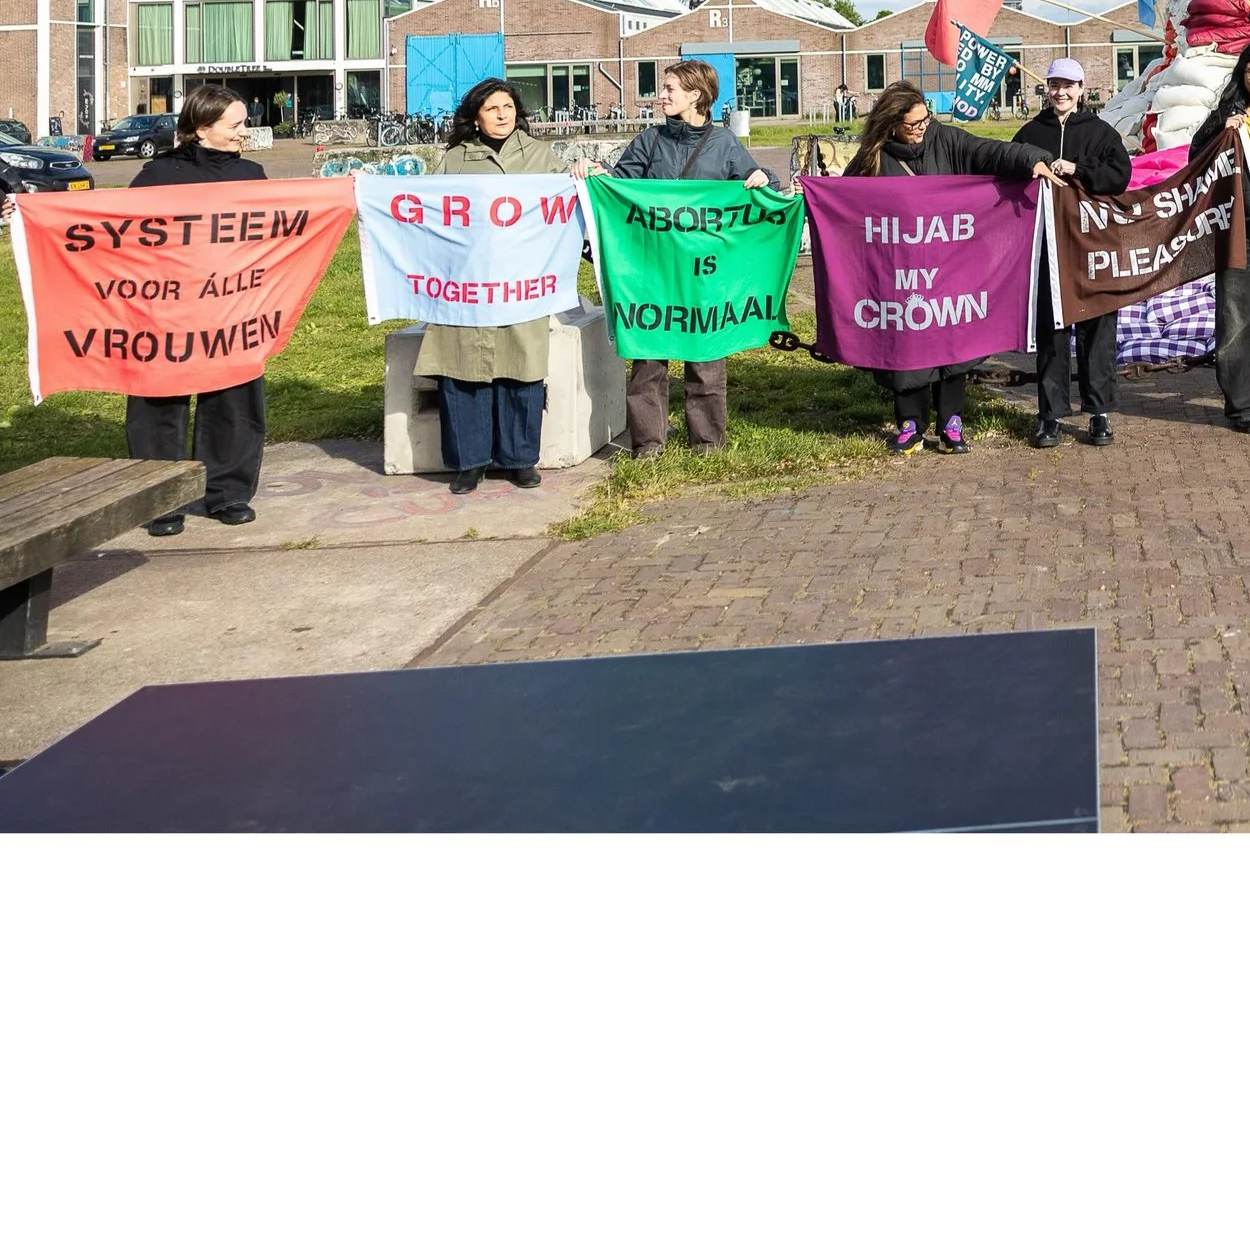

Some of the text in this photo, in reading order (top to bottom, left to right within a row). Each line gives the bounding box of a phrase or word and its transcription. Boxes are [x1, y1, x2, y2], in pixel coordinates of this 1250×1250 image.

[709, 9, 729, 28] R3
[960, 30, 1008, 70] POWER
[969, 73, 996, 93] MM
[980, 62, 1002, 80] BY
[64, 209, 309, 252] SYSTEEM
[864, 213, 976, 245] HIJAB
[693, 255, 718, 277] IS
[895, 267, 940, 290] MY
[95, 279, 181, 301] VOOR
[406, 274, 558, 305] TOGETHER
[613, 294, 778, 335] NORMAAL
[853, 291, 988, 331] CROWN
[63, 310, 283, 363] VROUWEN
